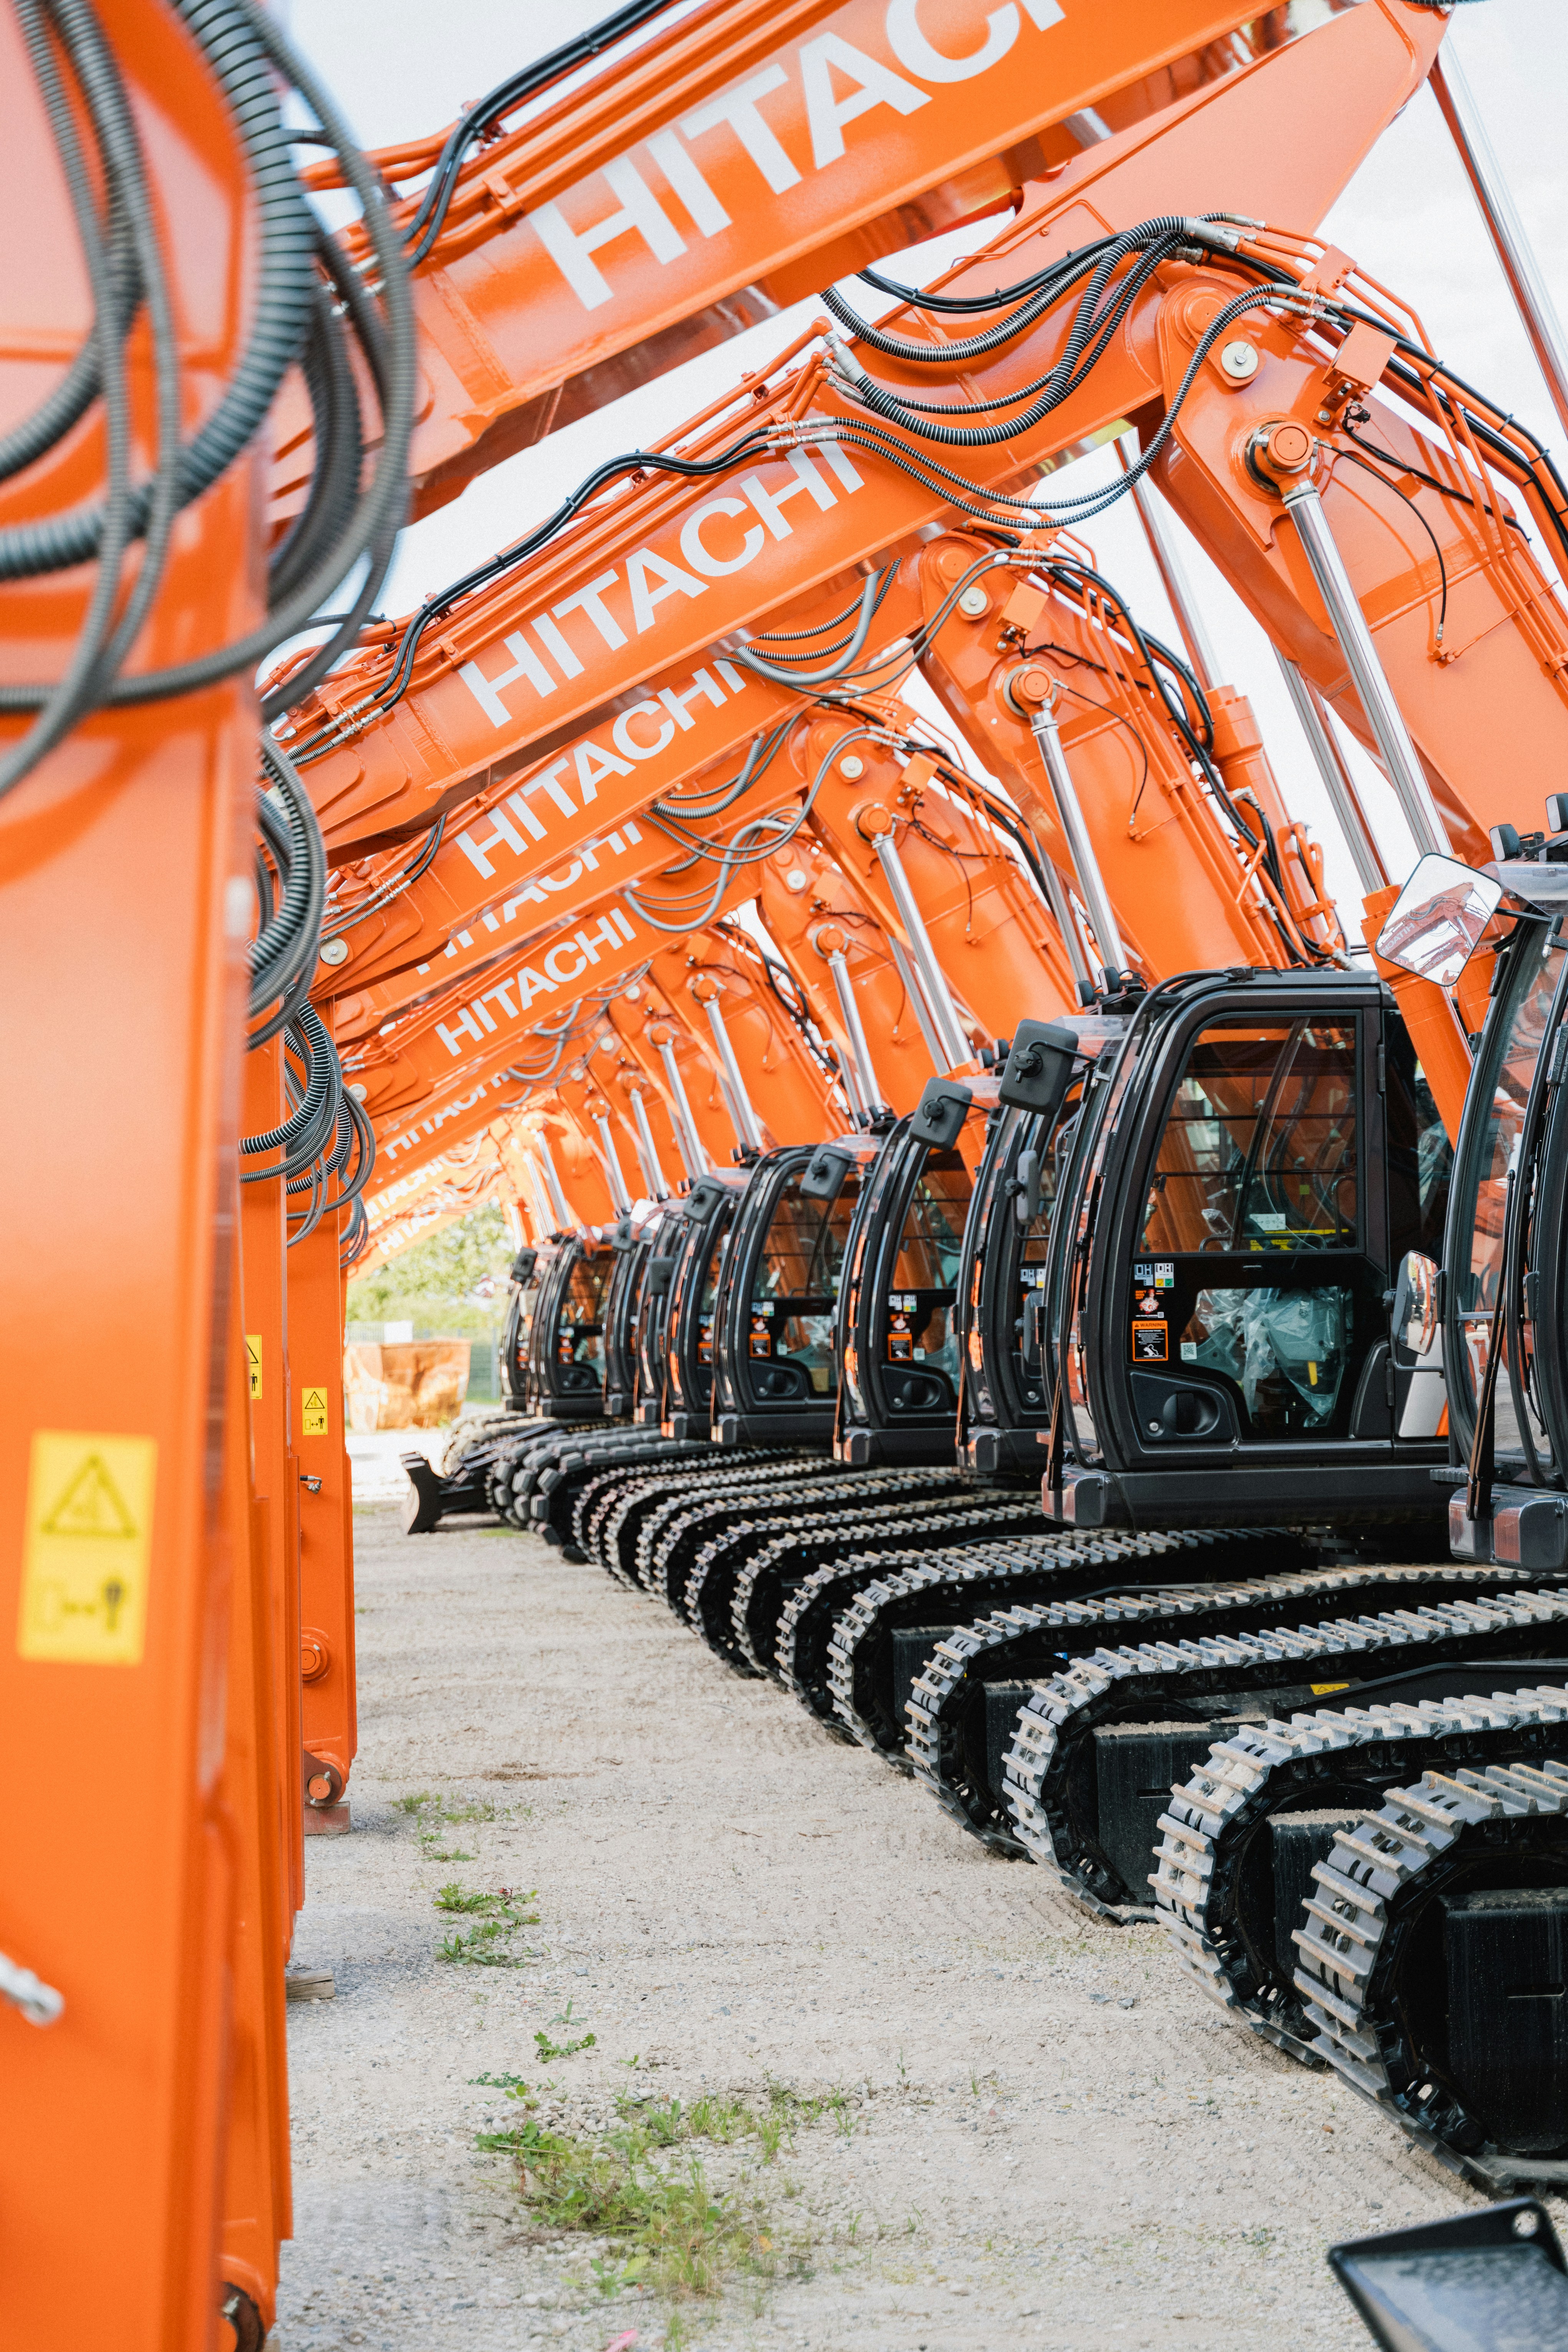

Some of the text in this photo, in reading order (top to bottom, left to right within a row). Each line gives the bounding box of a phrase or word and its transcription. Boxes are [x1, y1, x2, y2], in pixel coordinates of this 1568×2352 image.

[529, 0, 1067, 311] HITAC
[458, 428, 865, 728] HITACHI
[454, 660, 747, 880] HITACHI
[434, 907, 637, 1057] HITACHI
